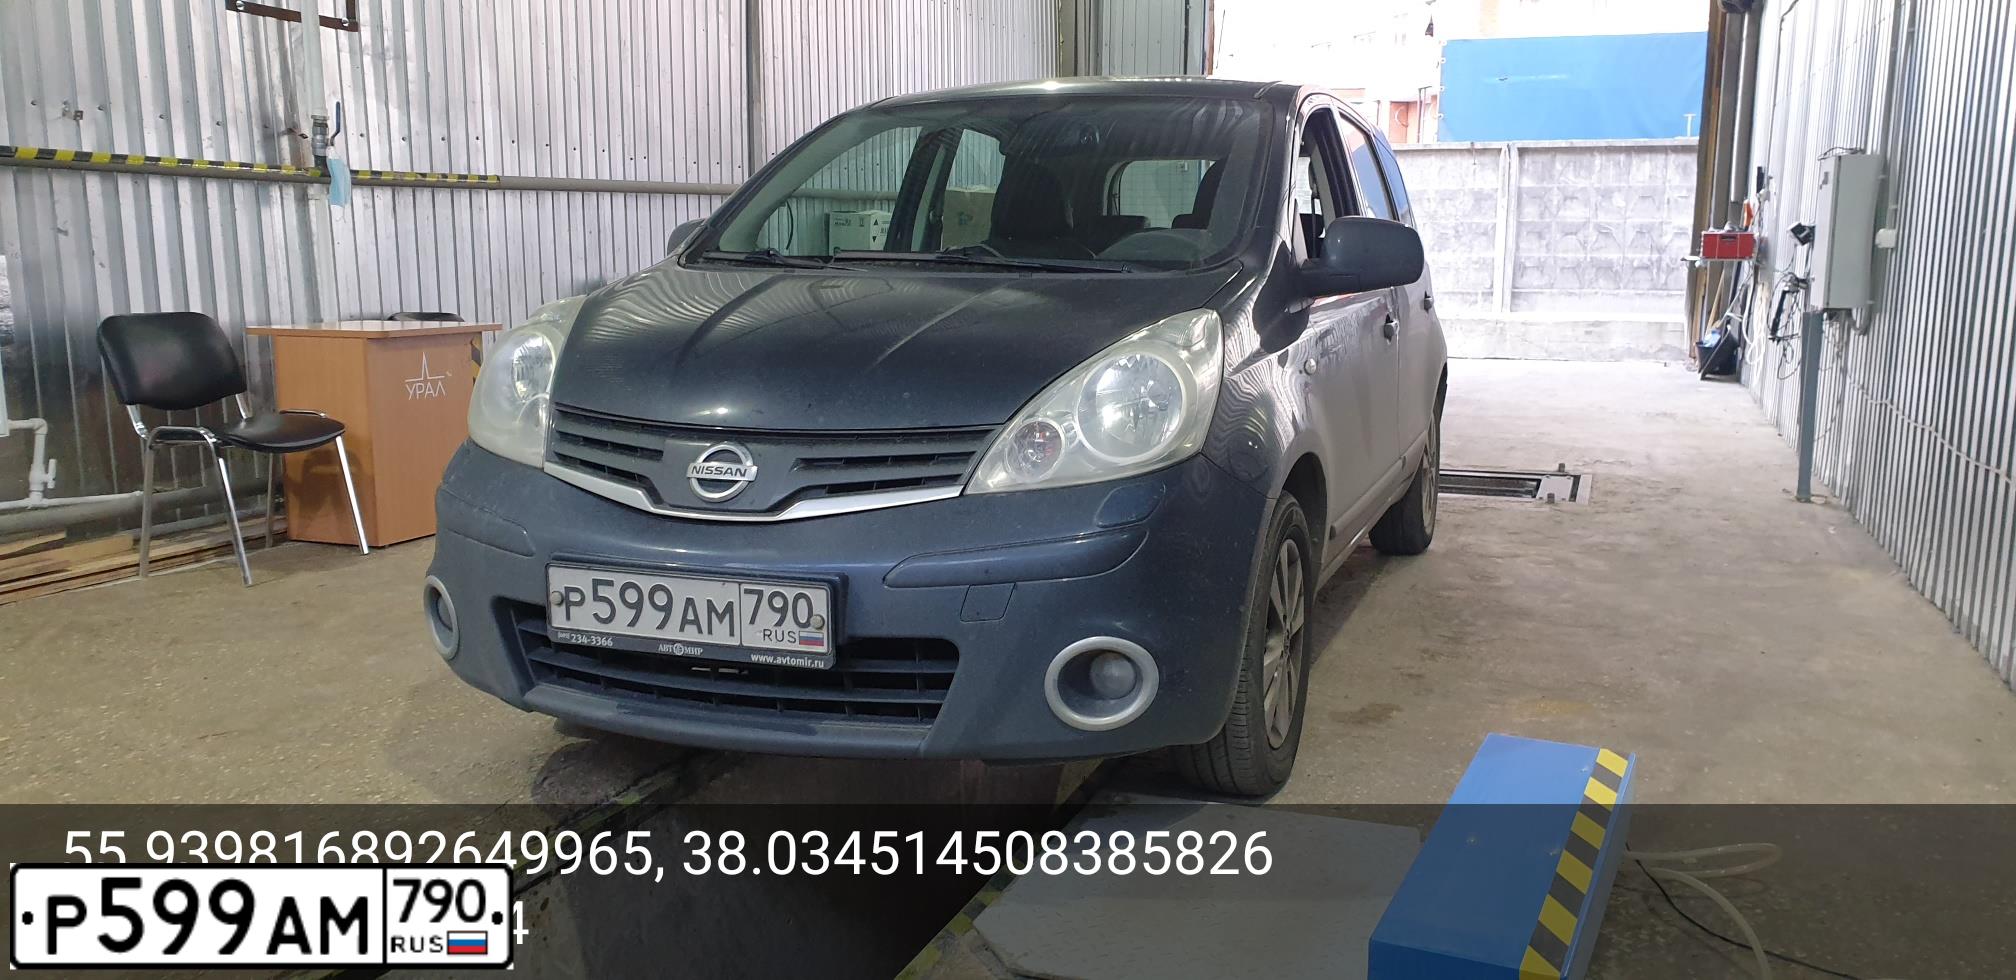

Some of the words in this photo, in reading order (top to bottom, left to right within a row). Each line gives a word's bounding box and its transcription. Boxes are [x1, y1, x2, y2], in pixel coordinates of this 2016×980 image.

[405, 380, 446, 400] УРАЛ
[692, 465, 748, 477] NISSAN
[743, 588, 814, 628] 790
[570, 634, 613, 647] 234-3366
[763, 629, 797, 644] RUS
[750, 653, 825, 668] www.avtomir.ru
